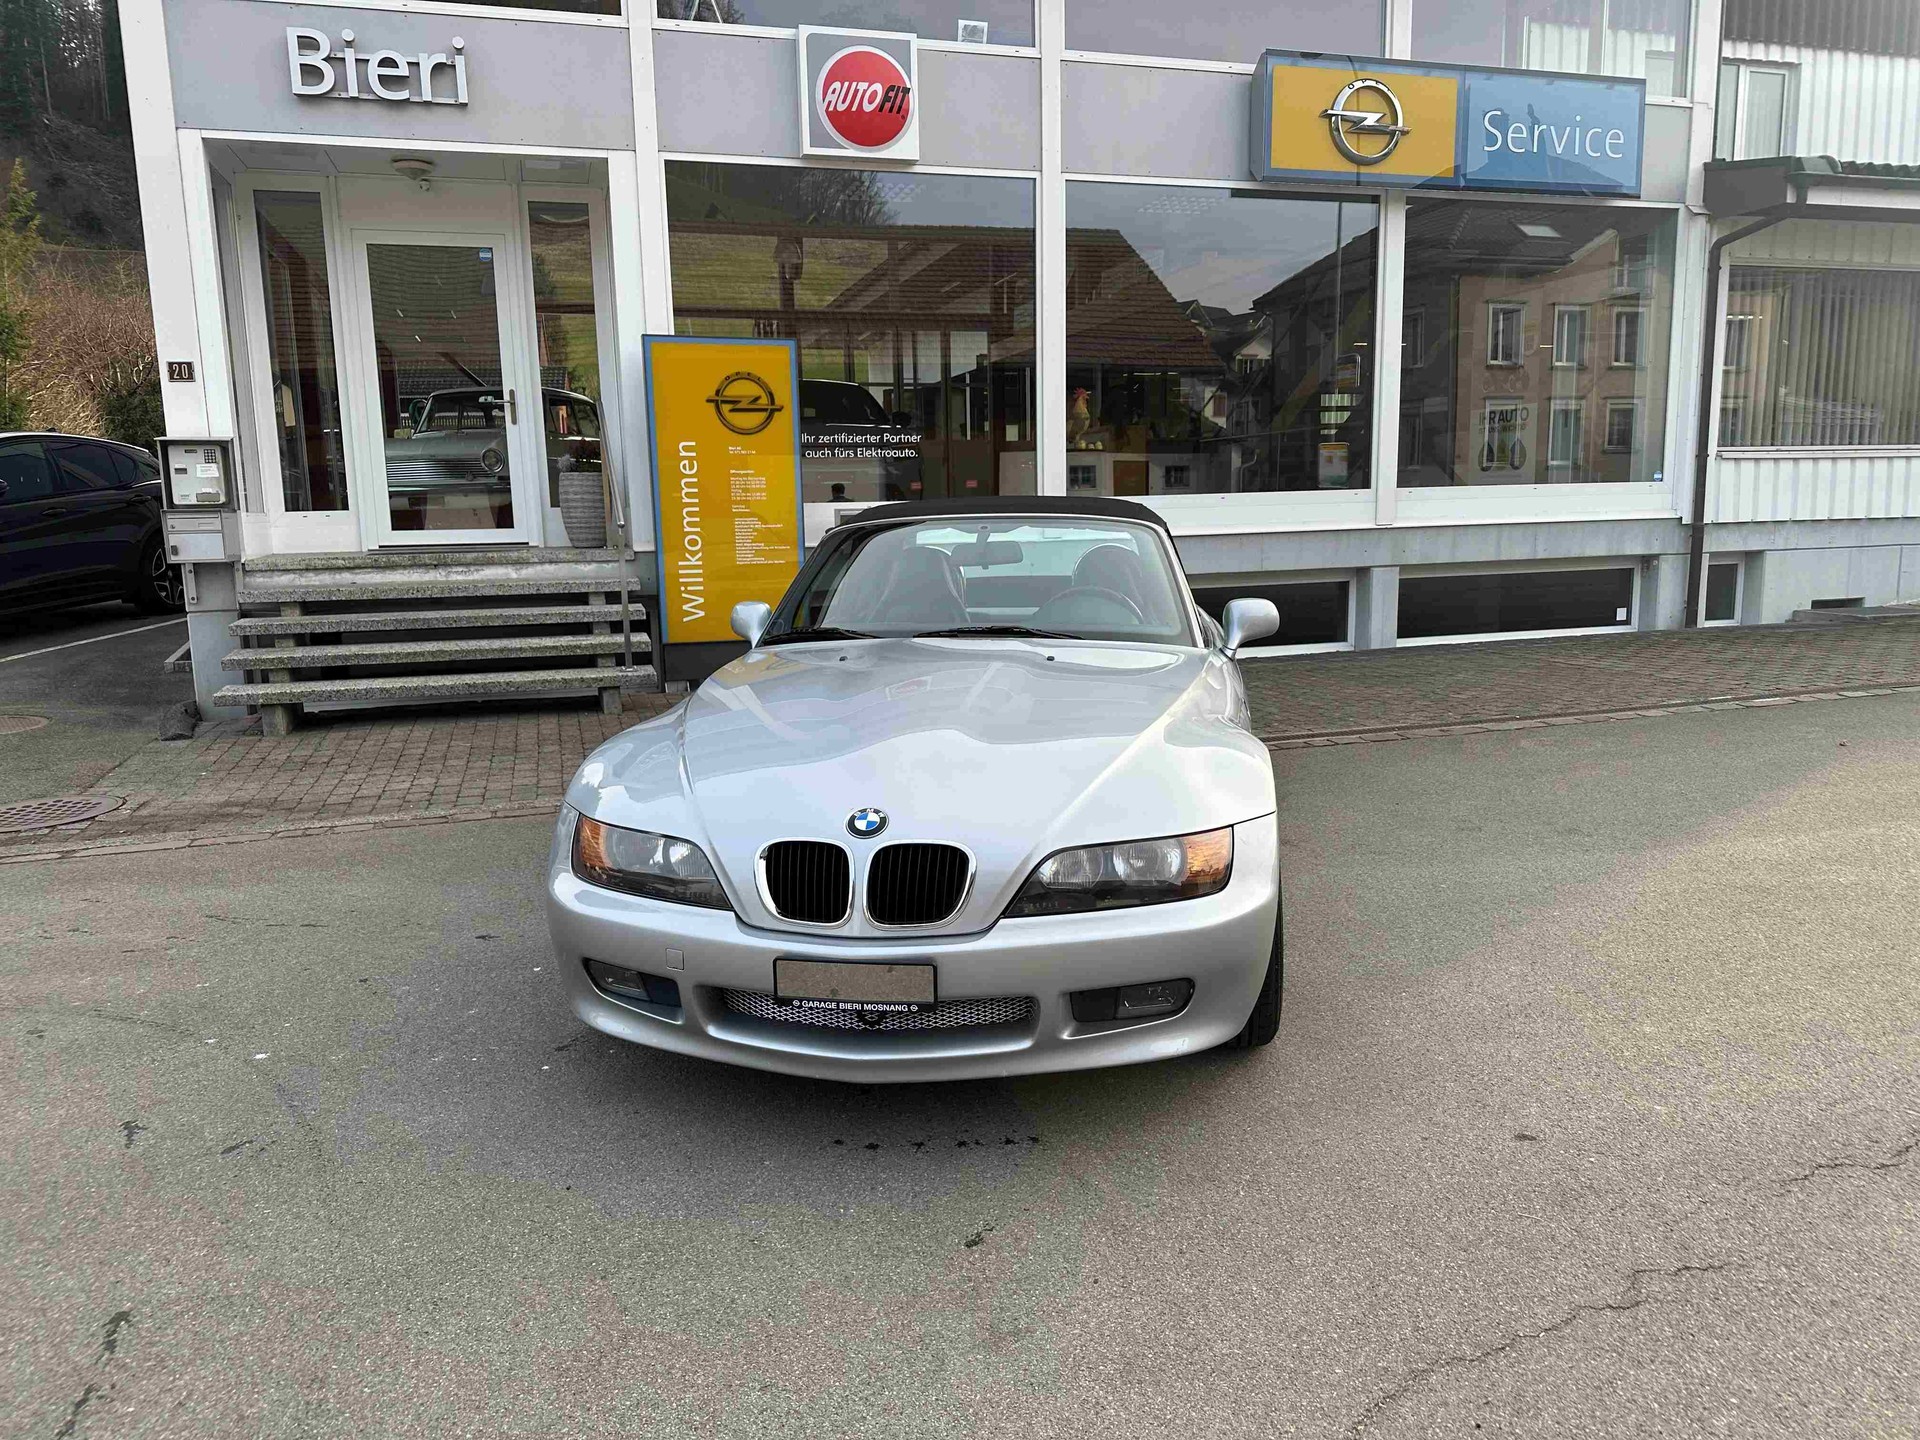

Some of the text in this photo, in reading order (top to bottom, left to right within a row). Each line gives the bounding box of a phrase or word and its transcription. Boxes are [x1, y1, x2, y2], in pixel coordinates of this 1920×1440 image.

[286, 27, 469, 104] Bieri
[823, 81, 911, 114] AUTOFIT
[1483, 110, 1625, 158] Service
[172, 363, 188, 379] 20
[801, 432, 921, 443] Ihr zertifizierter Partner
[805, 448, 919, 458] auch fürs Elektroauto.
[678, 441, 706, 623] Willkommen
[801, 1000, 909, 1012] GARAGE BIERI MOSNANG
